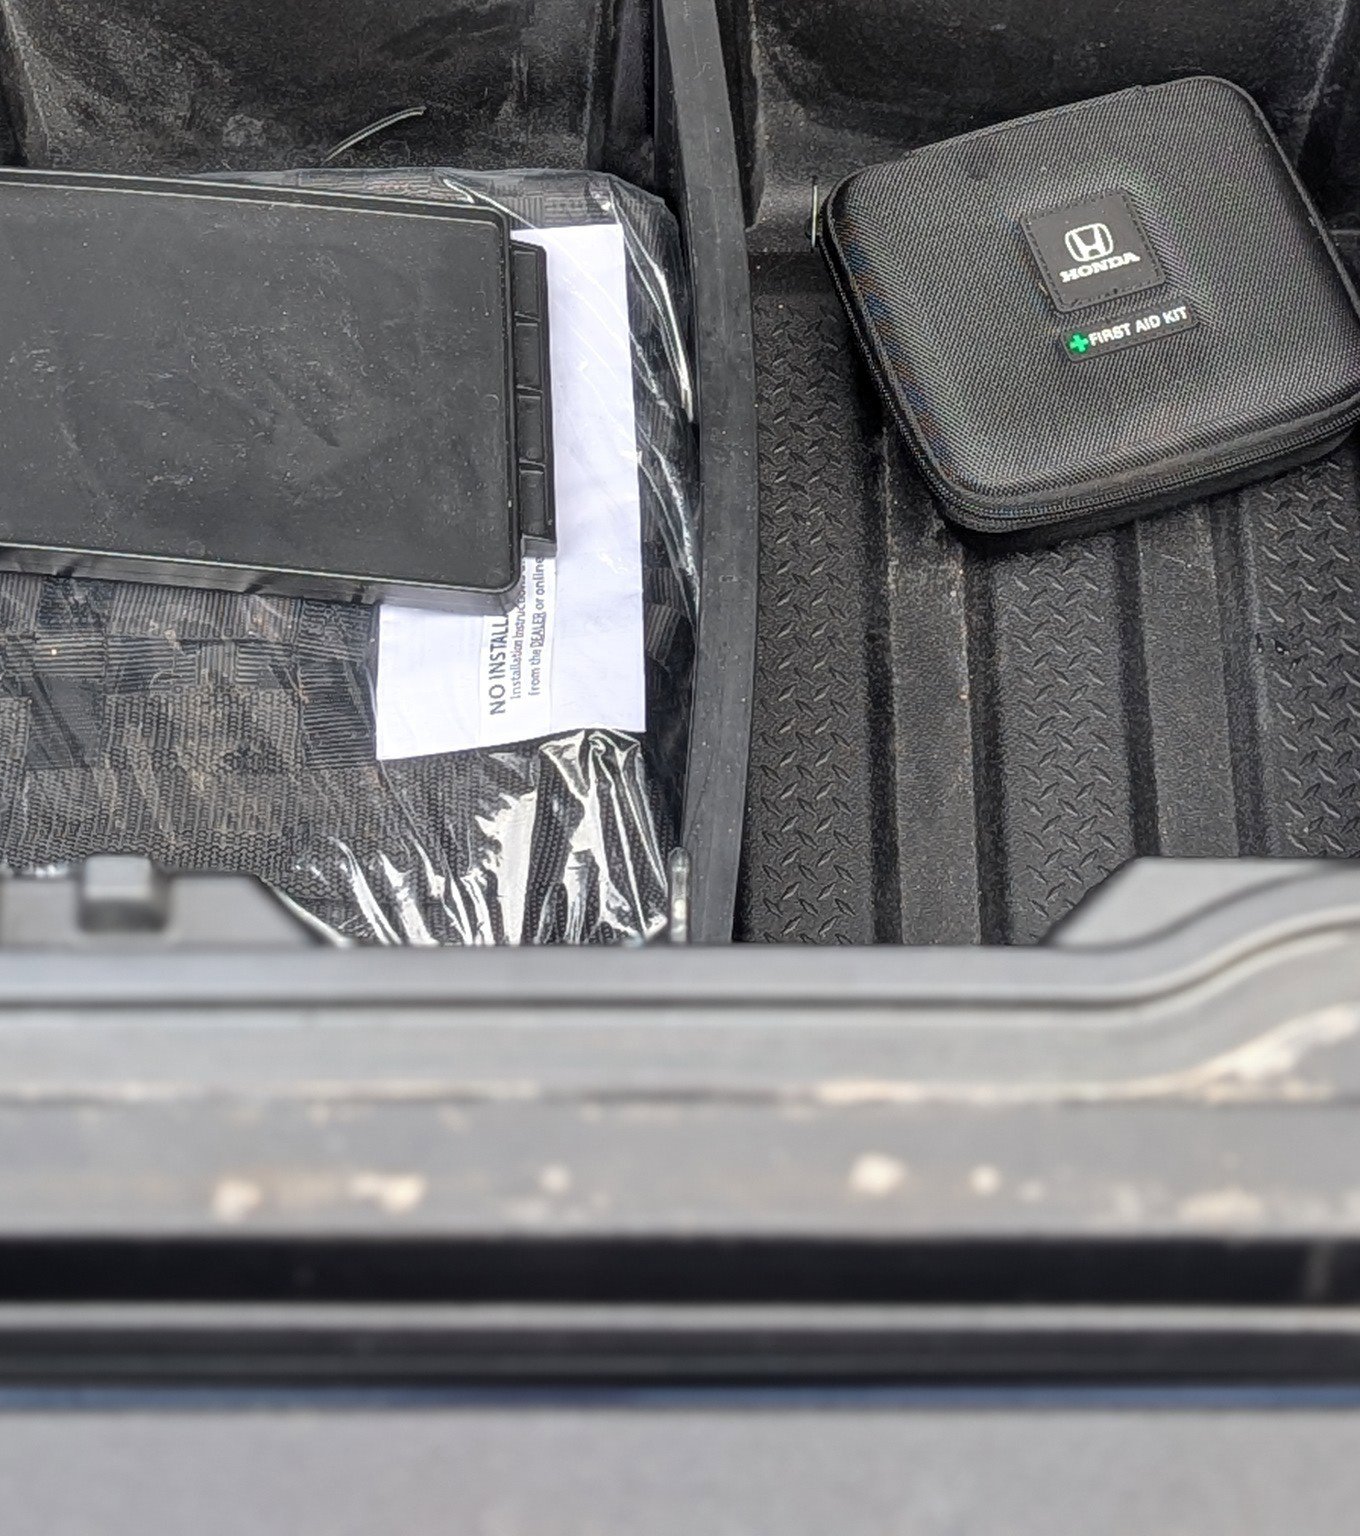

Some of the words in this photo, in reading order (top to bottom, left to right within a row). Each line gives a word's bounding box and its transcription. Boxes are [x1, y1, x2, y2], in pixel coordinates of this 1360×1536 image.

[1059, 252, 1140, 283] HONDA
[1088, 323, 1131, 346] FIRST
[1135, 315, 1161, 333] AID
[1163, 307, 1188, 324] KIT
[532, 557, 545, 595] online
[534, 598, 545, 611] or
[489, 613, 509, 680] INSTALL
[530, 612, 546, 648] DEALER
[510, 639, 523, 699] Installation
[529, 649, 542, 665] the
[529, 668, 541, 696] from
[489, 684, 506, 715] NO
